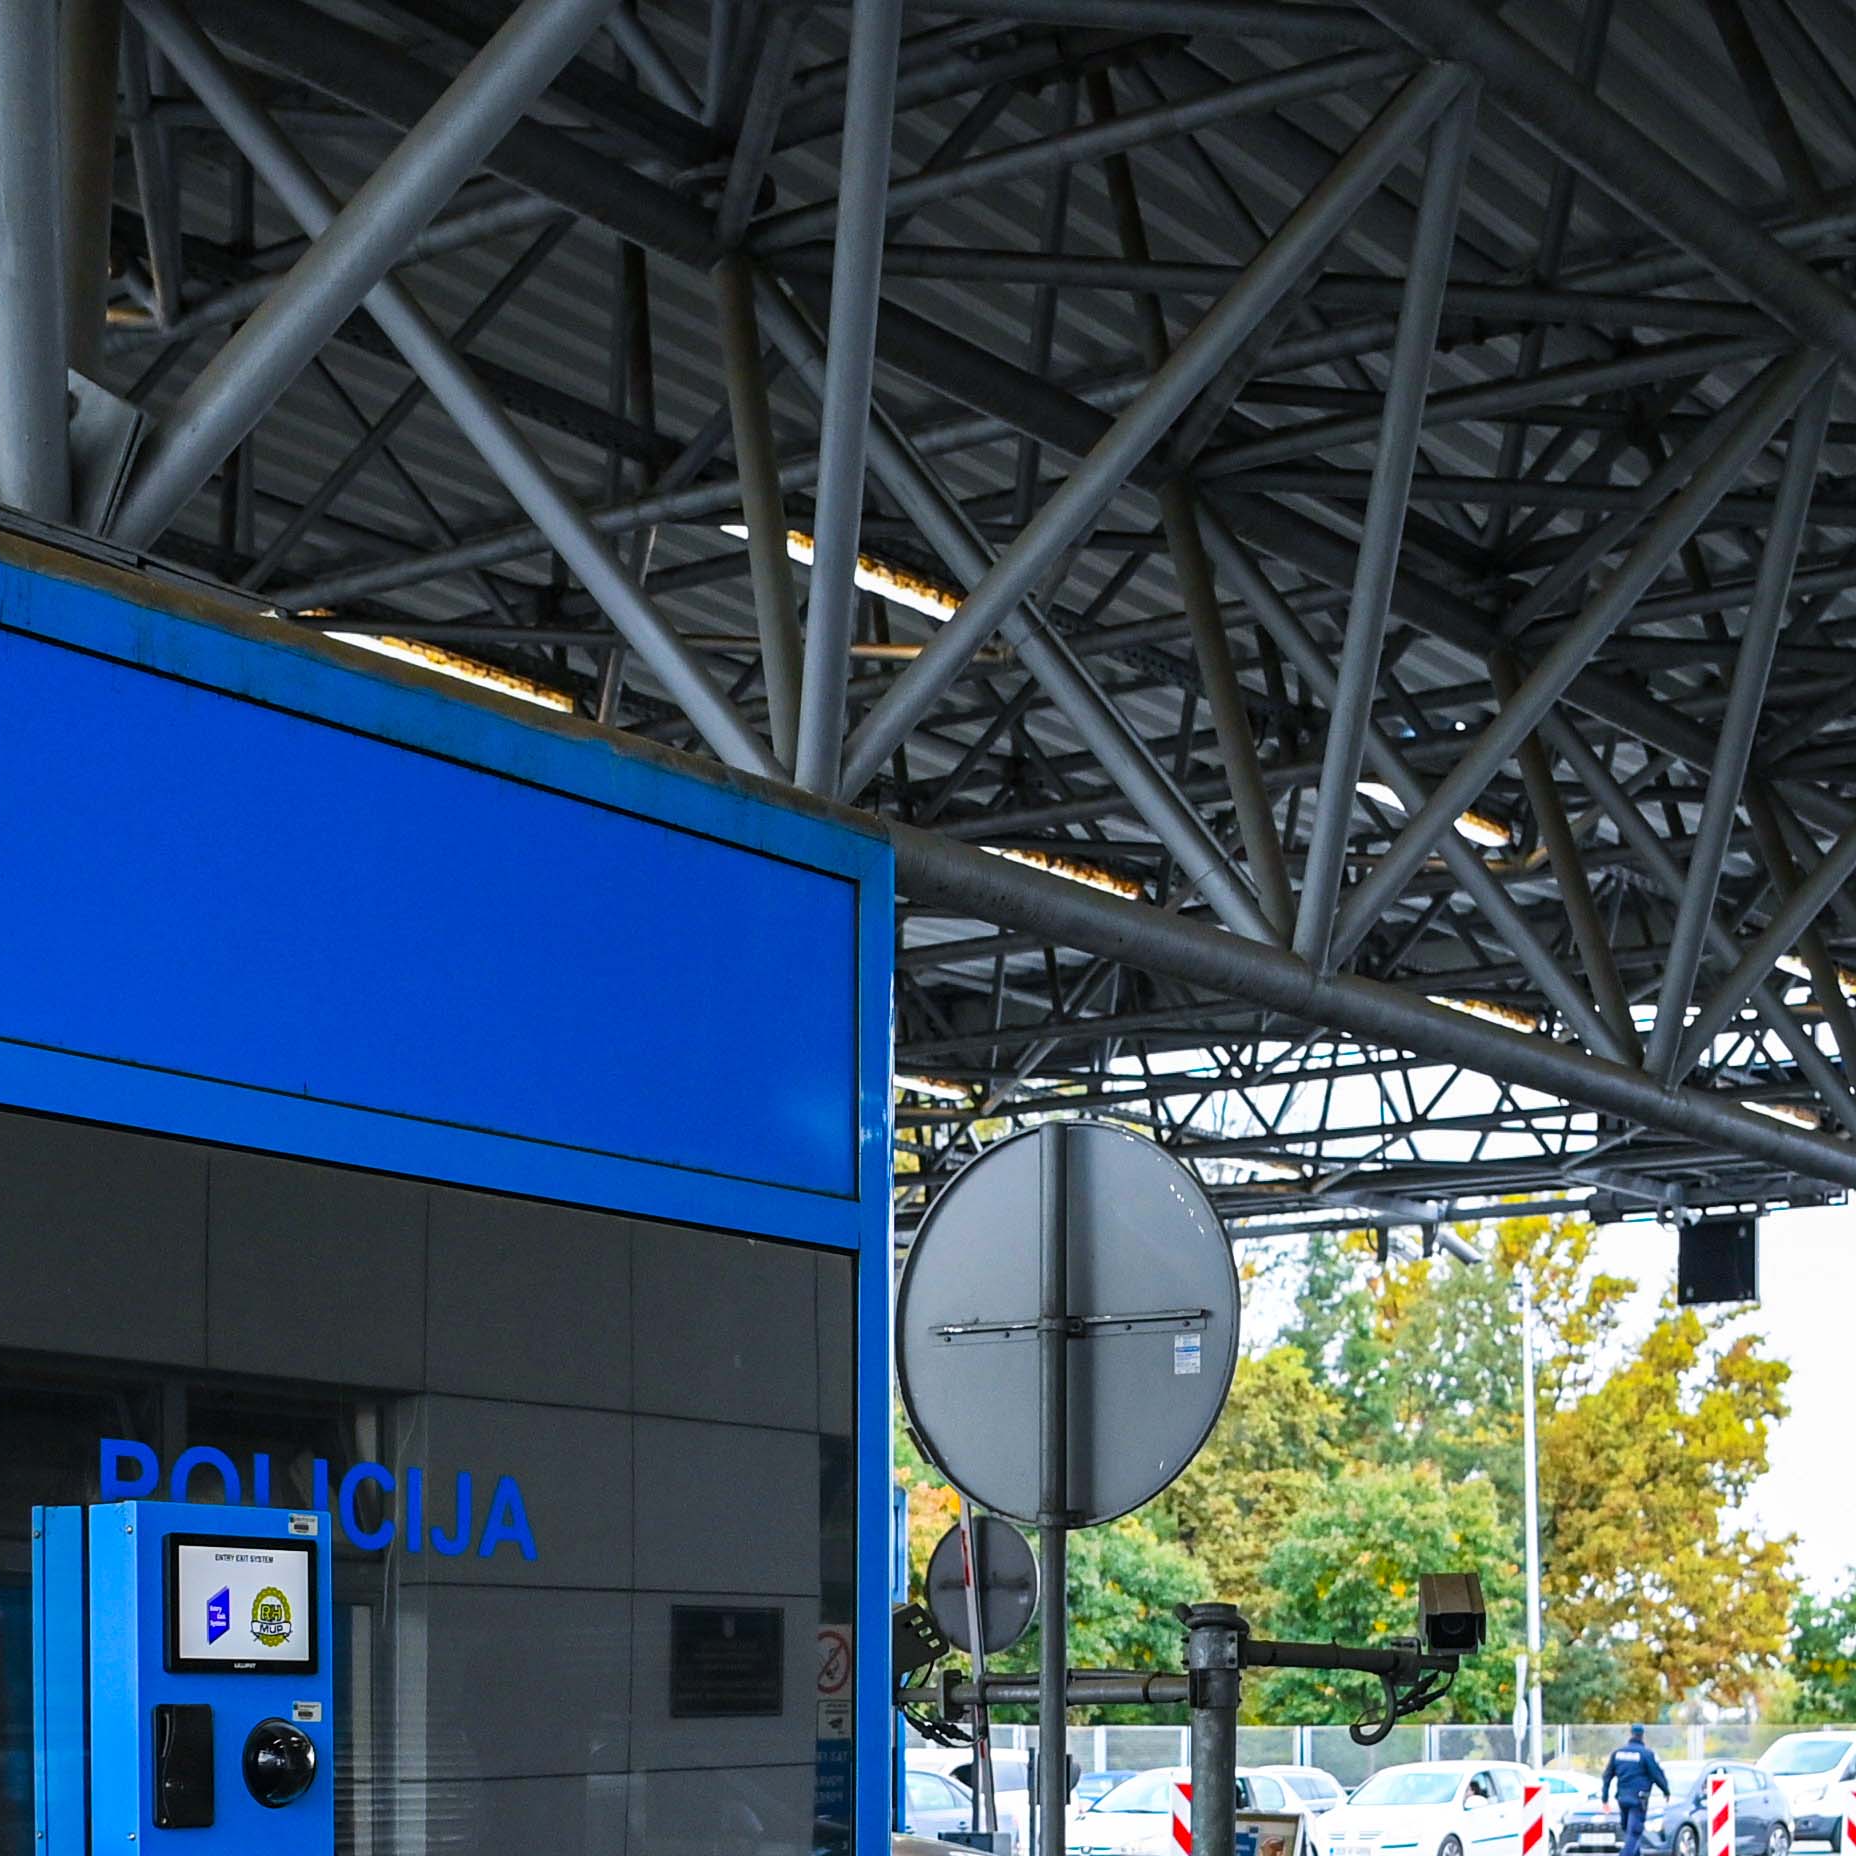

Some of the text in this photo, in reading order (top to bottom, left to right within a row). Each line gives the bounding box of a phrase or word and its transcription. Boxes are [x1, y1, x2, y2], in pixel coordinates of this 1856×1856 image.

[215, 1553, 274, 1563] ENTRY EXIT SYSTEM
[259, 1623, 284, 1634] MUP
